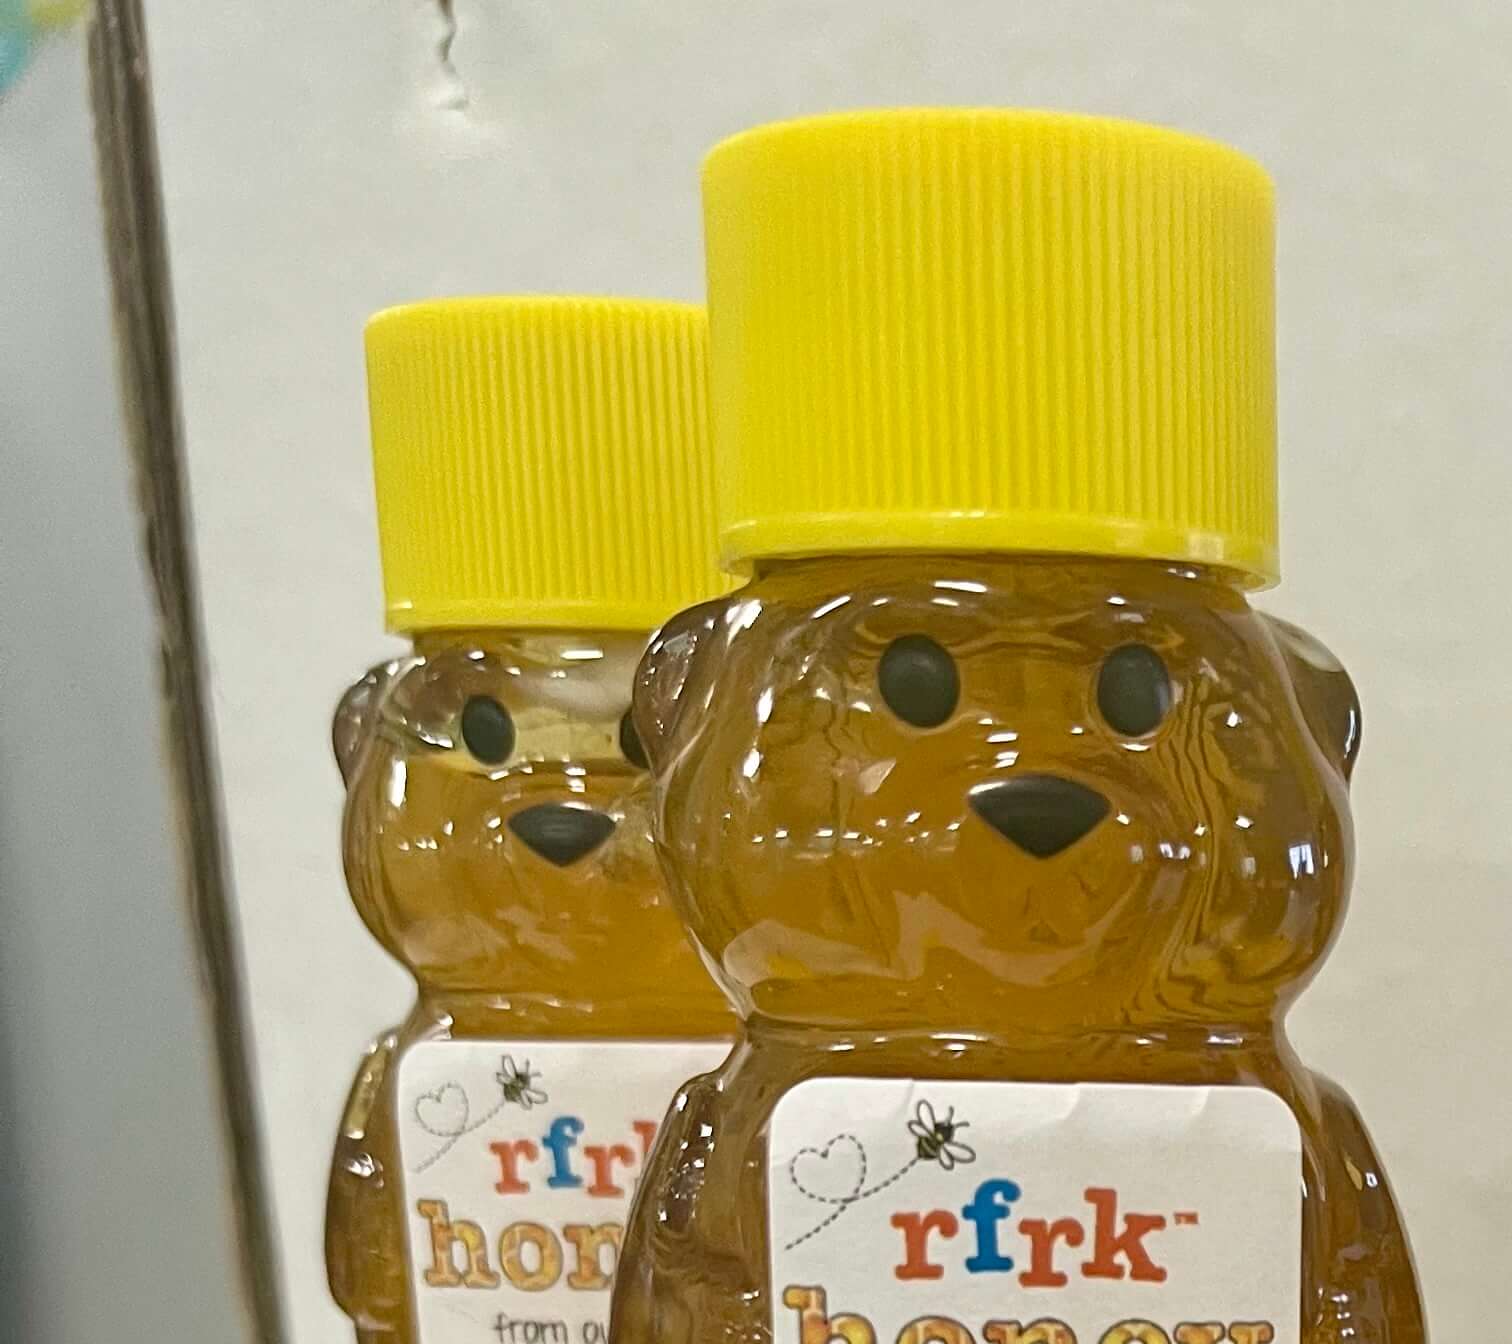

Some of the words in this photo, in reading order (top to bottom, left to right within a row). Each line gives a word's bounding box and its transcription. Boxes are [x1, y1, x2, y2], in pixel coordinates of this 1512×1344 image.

[489, 1116, 657, 1197] rfr
[417, 1199, 623, 1291] hon
[492, 1313, 568, 1344] from
